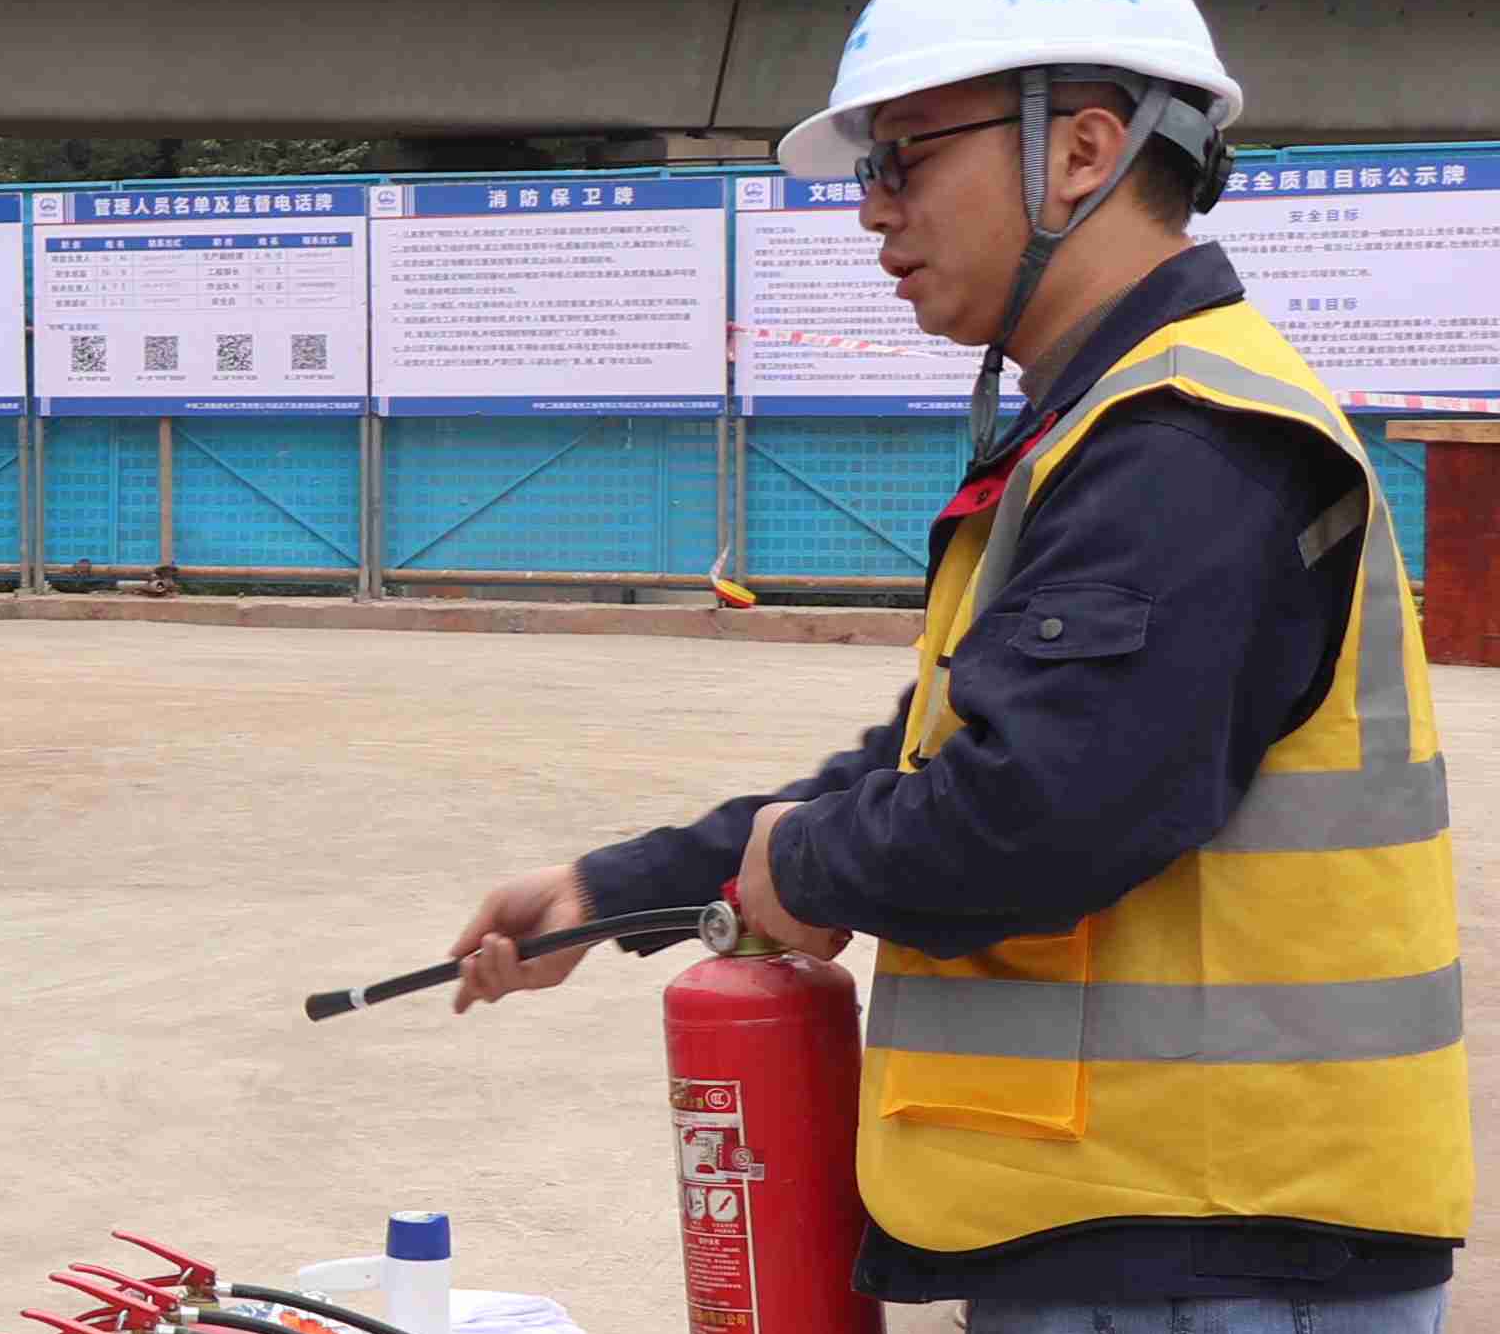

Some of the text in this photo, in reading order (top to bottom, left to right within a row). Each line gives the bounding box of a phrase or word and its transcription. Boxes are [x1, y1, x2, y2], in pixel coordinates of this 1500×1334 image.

[94, 194, 333, 216] 管理人员名单及监督电话牌
[488, 186, 636, 209] 消防保卫牌
